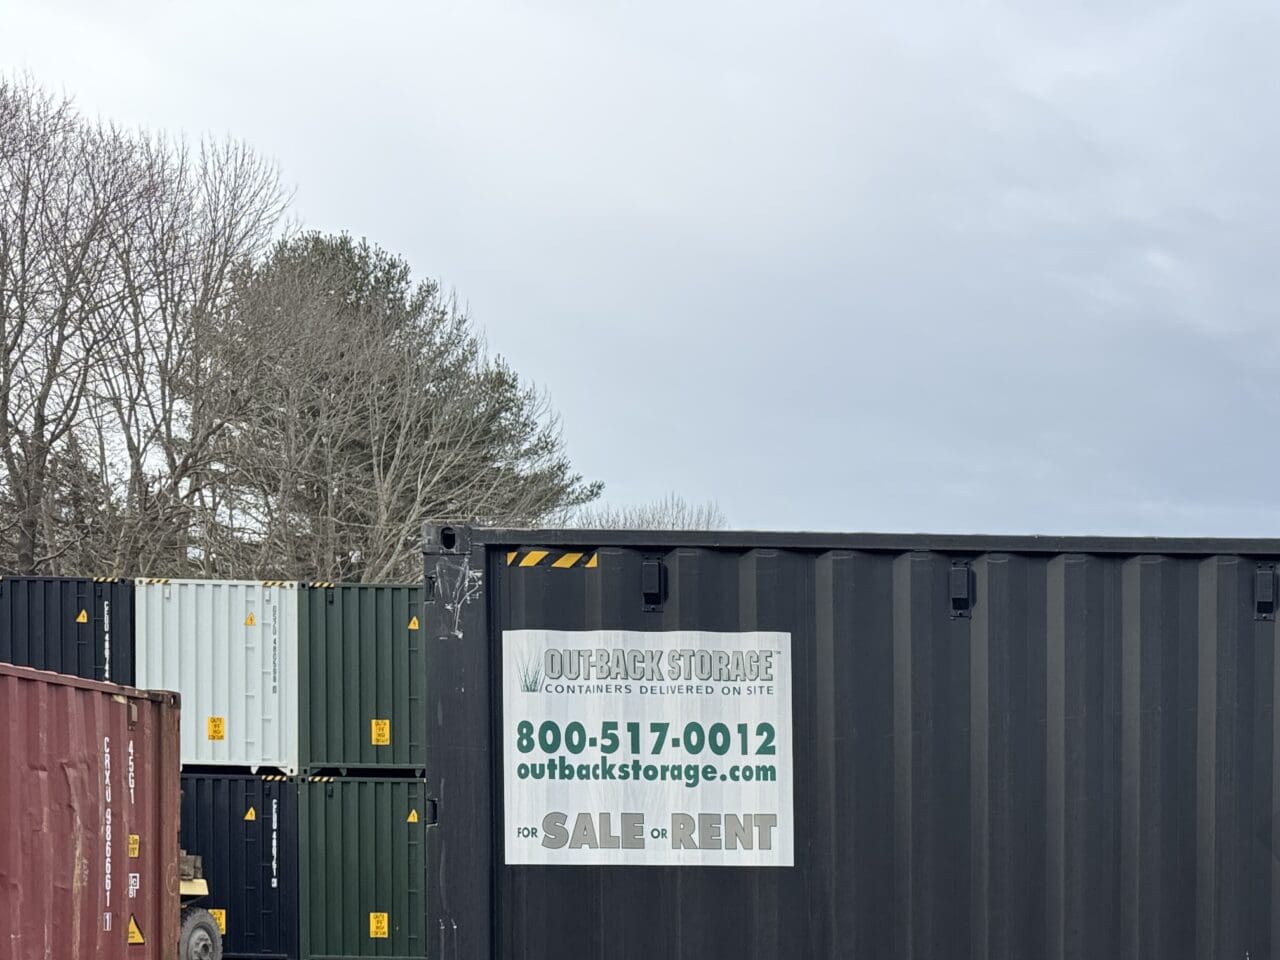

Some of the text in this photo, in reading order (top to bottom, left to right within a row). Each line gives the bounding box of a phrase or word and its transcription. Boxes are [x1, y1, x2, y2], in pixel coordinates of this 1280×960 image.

[668, 649, 774, 682] STORAGE
[545, 683, 774, 696] CONTAINERS DELIVERED ON SITE
[517, 720, 776, 756] 800-517-0012
[104, 736, 112, 803] CRXU
[517, 756, 777, 787] outbackstorage.com
[517, 811, 778, 851] FOR SALE OR RENT
